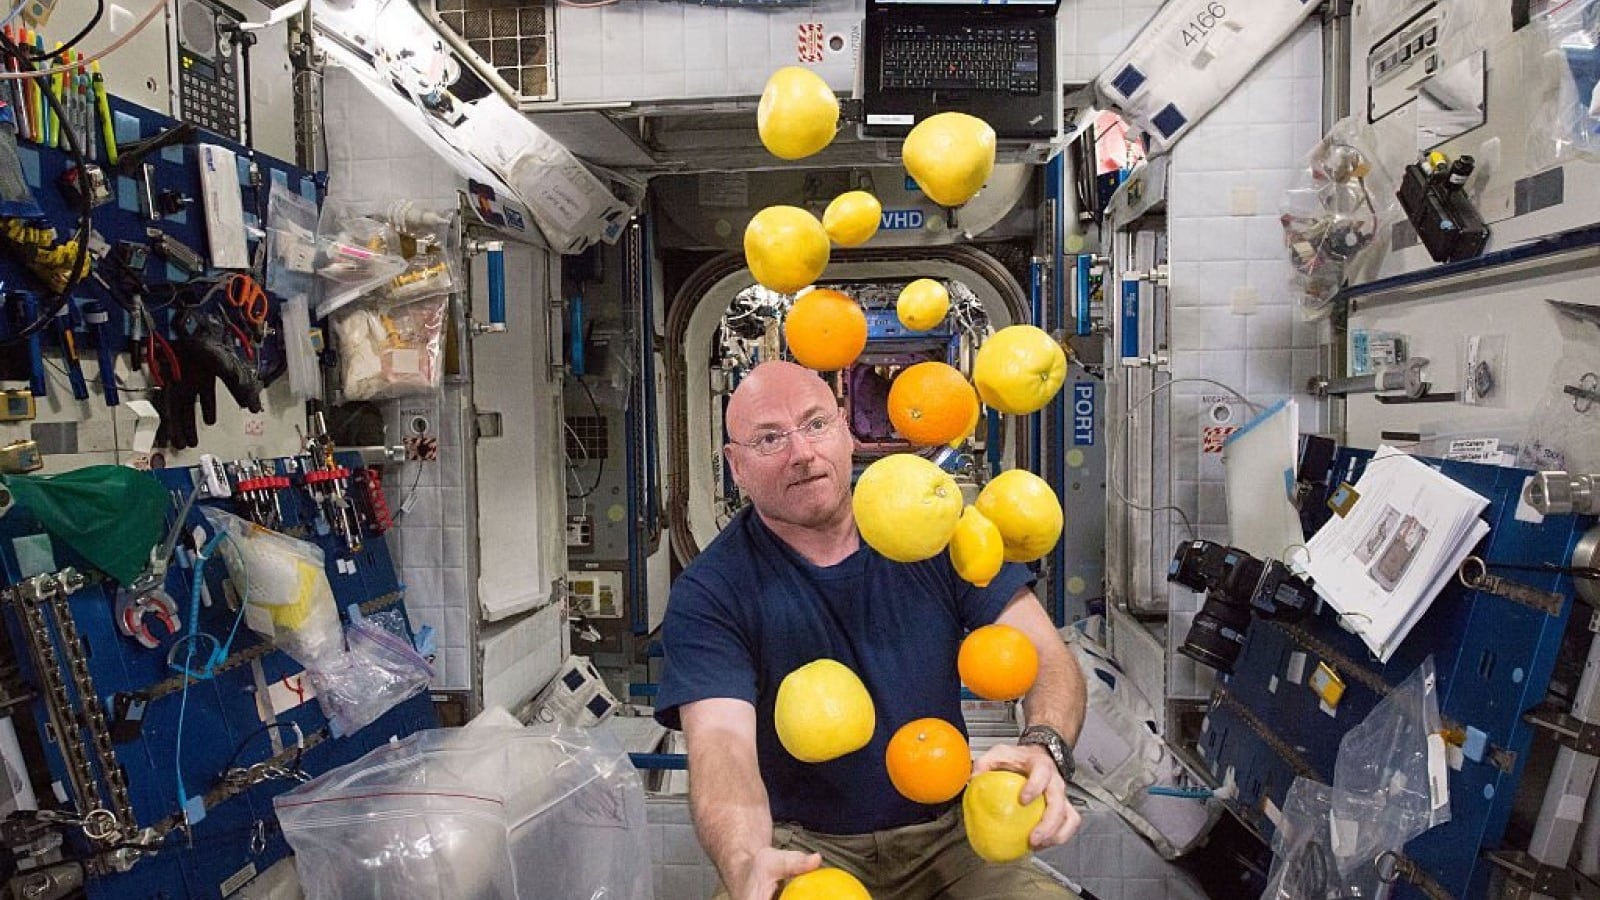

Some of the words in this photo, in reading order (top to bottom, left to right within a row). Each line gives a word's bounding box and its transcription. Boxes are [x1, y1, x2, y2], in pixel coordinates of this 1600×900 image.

[1182, 2, 1226, 46] 4166
[881, 211, 923, 228] VHD
[1076, 386, 1093, 444] PORT
